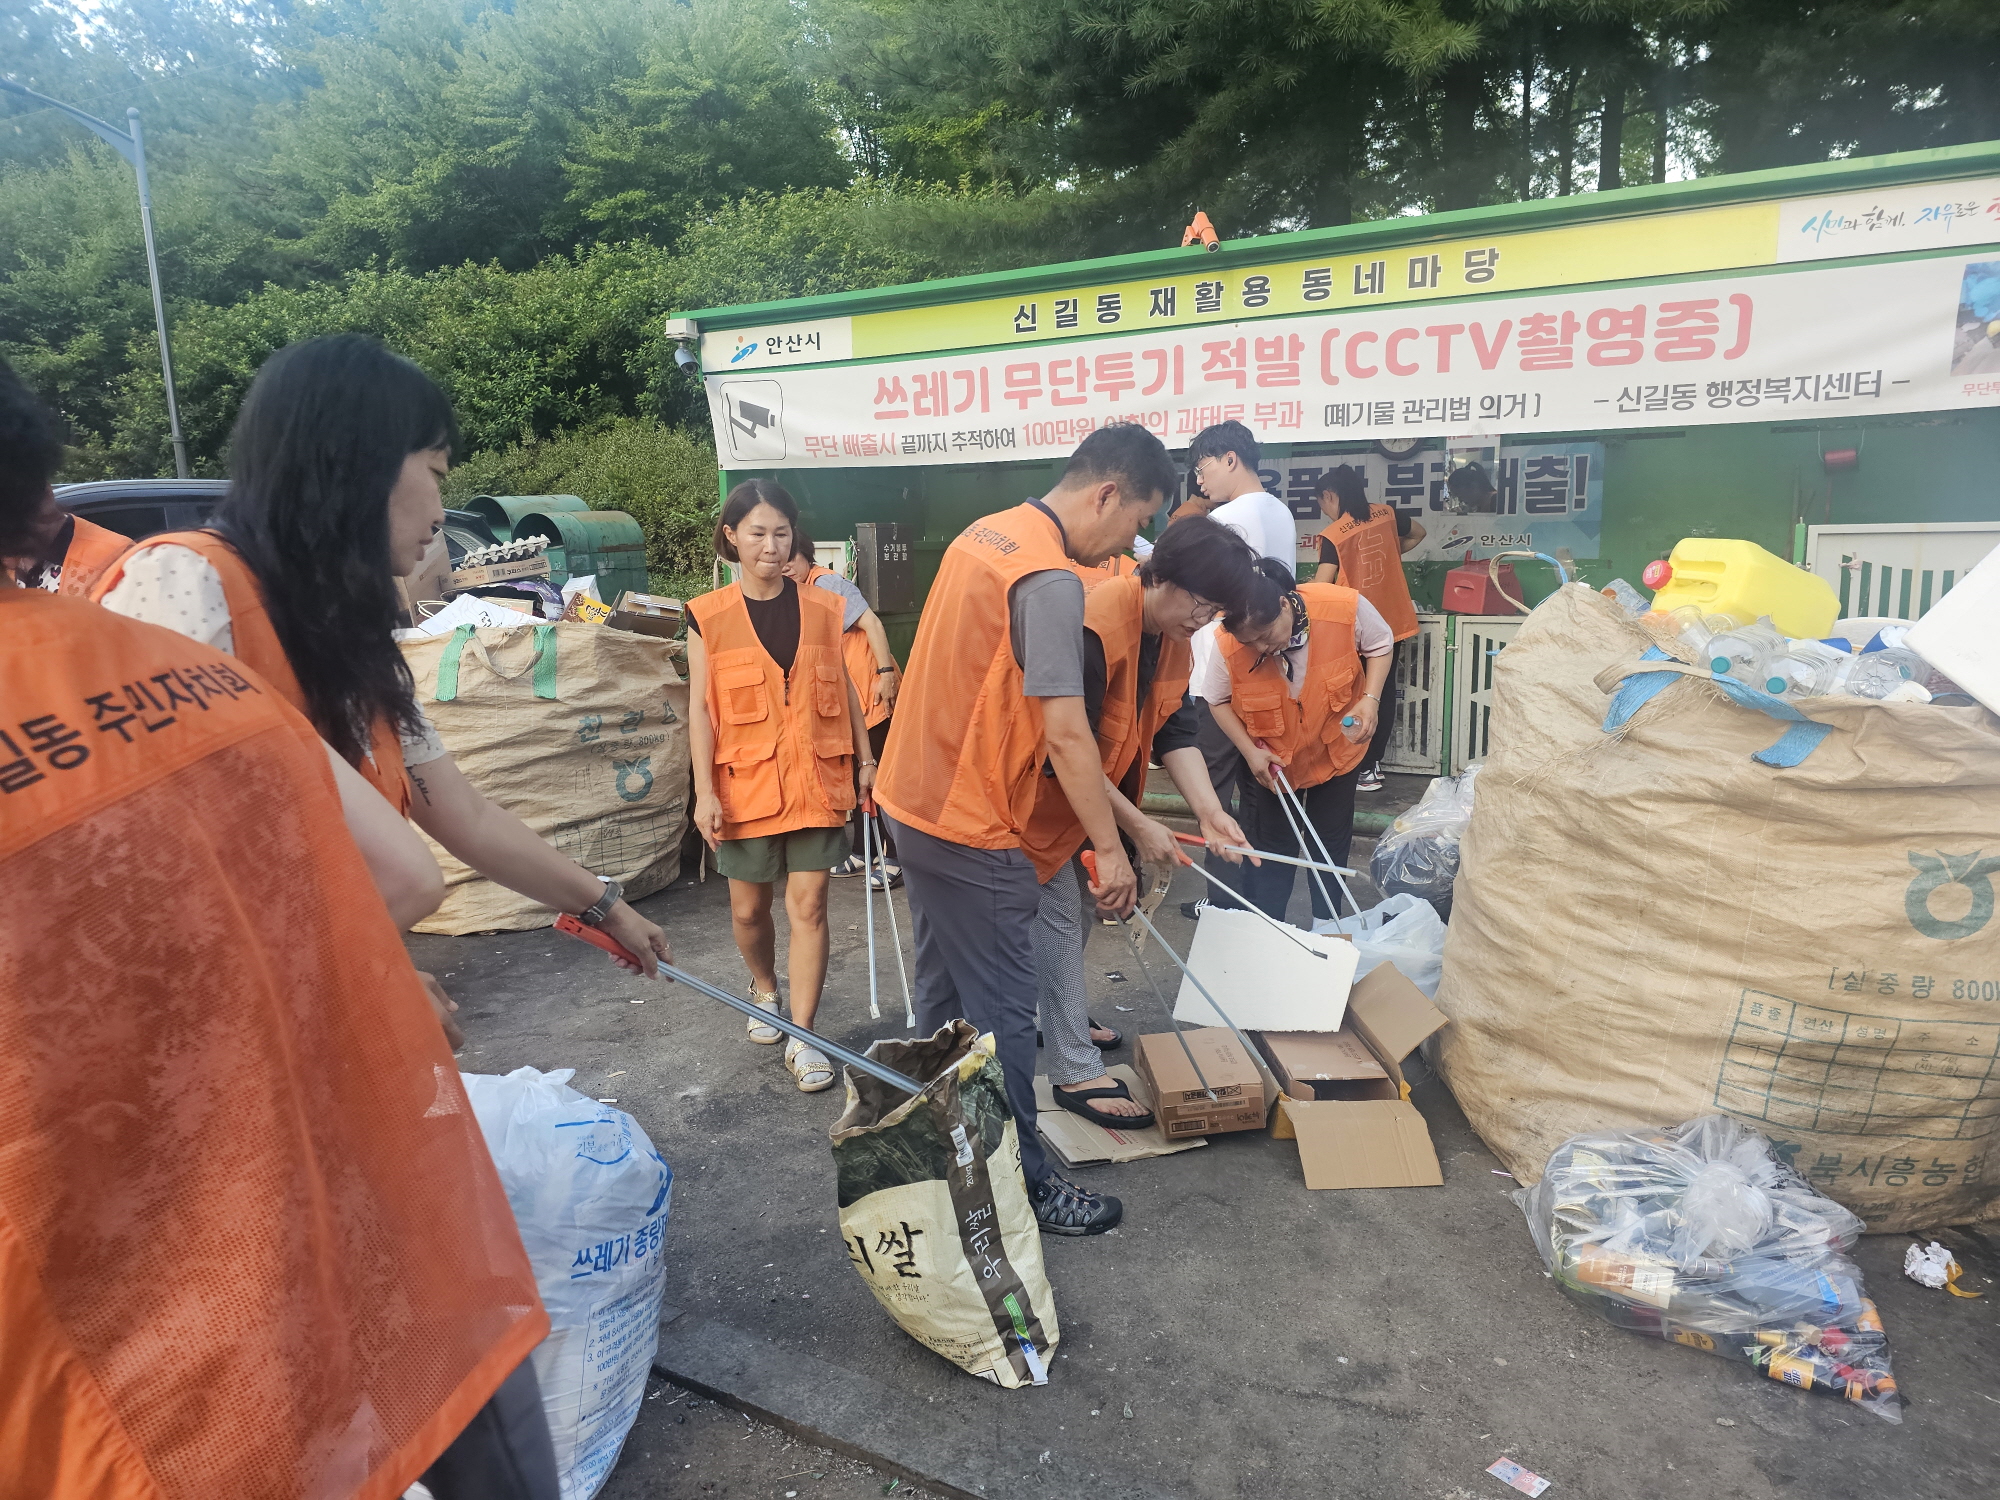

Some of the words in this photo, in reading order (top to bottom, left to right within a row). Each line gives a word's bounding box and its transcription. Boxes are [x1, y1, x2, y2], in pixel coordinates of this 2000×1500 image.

[1913, 201, 1981, 234] 자유로운
[1012, 291, 1123, 334] 신길동
[1148, 273, 1272, 319] 재활용
[1301, 247, 1502, 302] 동네마당
[764, 331, 823, 356] 안산시
[872, 365, 991, 420] 쓰레기
[1002, 343, 1185, 410] 무단투기
[1200, 331, 1306, 390] 적발
[1615, 381, 1698, 414] 신길동
[1704, 368, 1884, 410] 행정복지센터
[803, 434, 841, 460] 무단
[843, 430, 898, 458] 배출시
[900, 428, 949, 455] 끝까지
[951, 426, 1017, 453] 추적하여
[1021, 416, 1097, 447] 100만원
[1253, 400, 1305, 431] 부과
[1401, 396, 1472, 424] 관리법
[973, 527, 1021, 556] 주민자치회
[1480, 533, 1532, 547] 안산시
[84, 662, 263, 744] 주민자치회
[1803, 1016, 1834, 1033] 연산
[1855, 1025, 1887, 1040] 성명
[1809, 1150, 1988, 1187] 북시흥농협
[570, 1233, 631, 1280] 쓰레기
